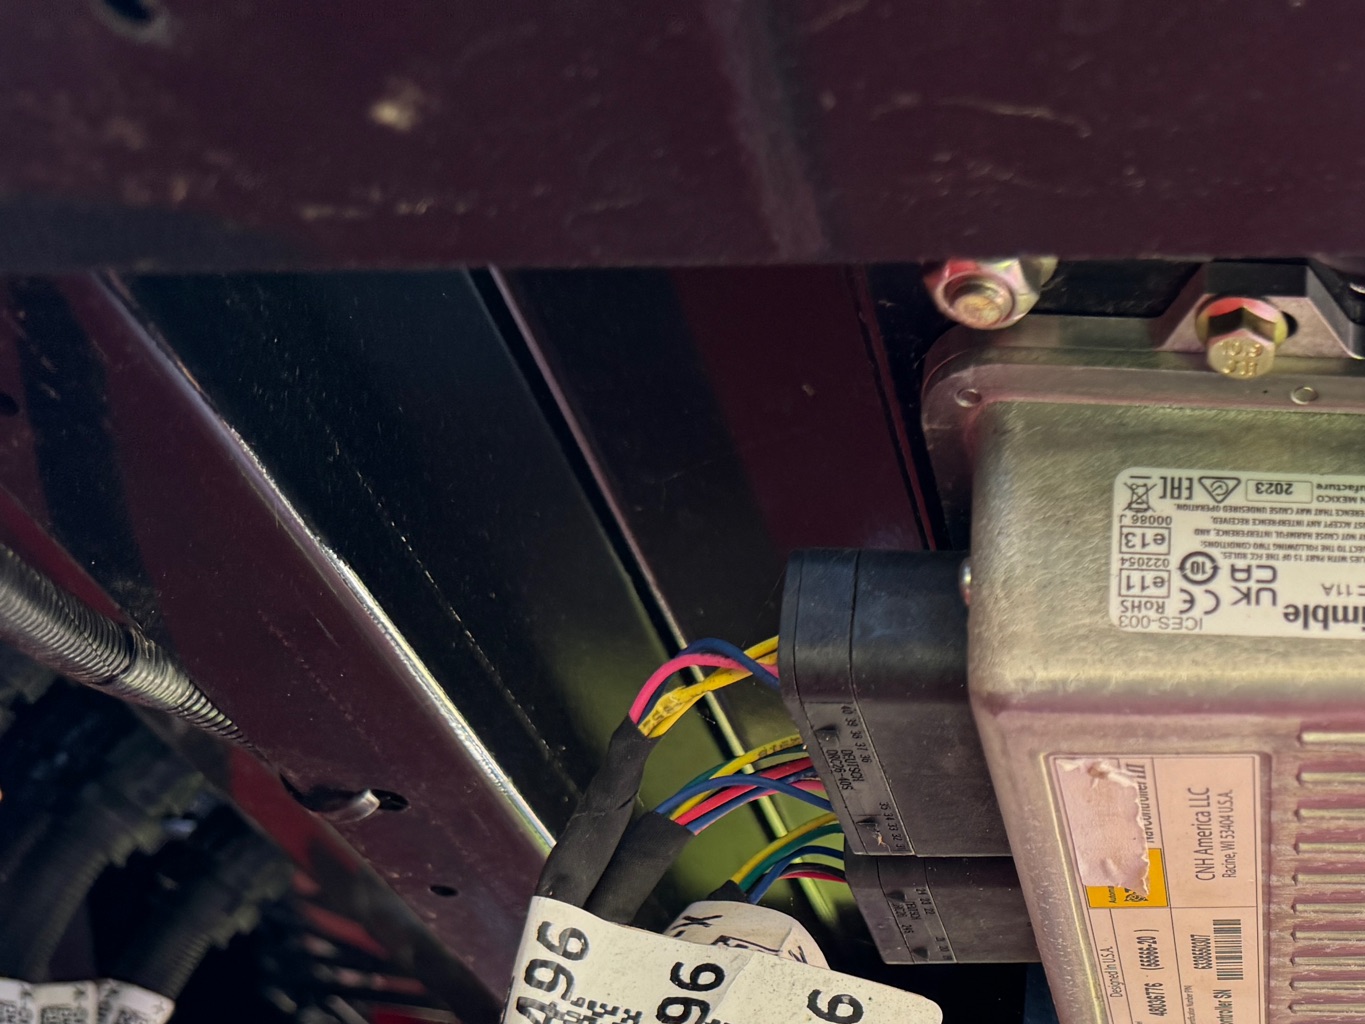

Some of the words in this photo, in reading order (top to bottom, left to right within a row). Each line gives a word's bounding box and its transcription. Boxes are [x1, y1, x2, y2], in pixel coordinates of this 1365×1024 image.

[1254, 482, 1294, 495] 2023
[1316, 495, 1358, 504] MEXICO
[1222, 505, 1267, 514] UNDESIRED
[1269, 507, 1294, 515] CAUSE
[1295, 508, 1312, 516] MAY
[1314, 508, 1333, 517] THAT
[1119, 514, 1127, 524] J
[1131, 514, 1172, 526] 00086
[1323, 521, 1351, 529] ACCEPT
[1194, 528, 1211, 536] AND
[1274, 531, 1313, 540] HARMFUL
[1315, 533, 1339, 541] CAUSE
[1123, 532, 1166, 549] e13
[1273, 543, 1319, 552] FOLLOWING
[1320, 545, 1335, 553] THE
[1120, 557, 1170, 568] 022054
[1265, 553, 1279, 561] THE
[1305, 554, 1325, 562] PART
[1190, 561, 1208, 575] 10
[1230, 564, 1277, 584] CA
[1125, 575, 1166, 592] e11
[1321, 583, 1353, 597] 11A
[1179, 588, 1221, 616] CE
[1230, 586, 1277, 607] UK
[1120, 599, 1166, 614] RoHS
[1118, 615, 1203, 631] ICES-003
[840, 750, 865, 782] DEUTSCH
[1187, 787, 1211, 808] LLC
[1217, 789, 1234, 813] U.S.A.
[1191, 811, 1214, 856] America
[1219, 815, 1235, 839] 53404
[1220, 840, 1235, 851] WI
[1194, 858, 1215, 881] CNH
[1221, 852, 1237, 878] Racine,
[1104, 971, 1124, 998] Designed
[1144, 982, 1168, 1016] 48036776
[1212, 989, 1232, 999] SN
